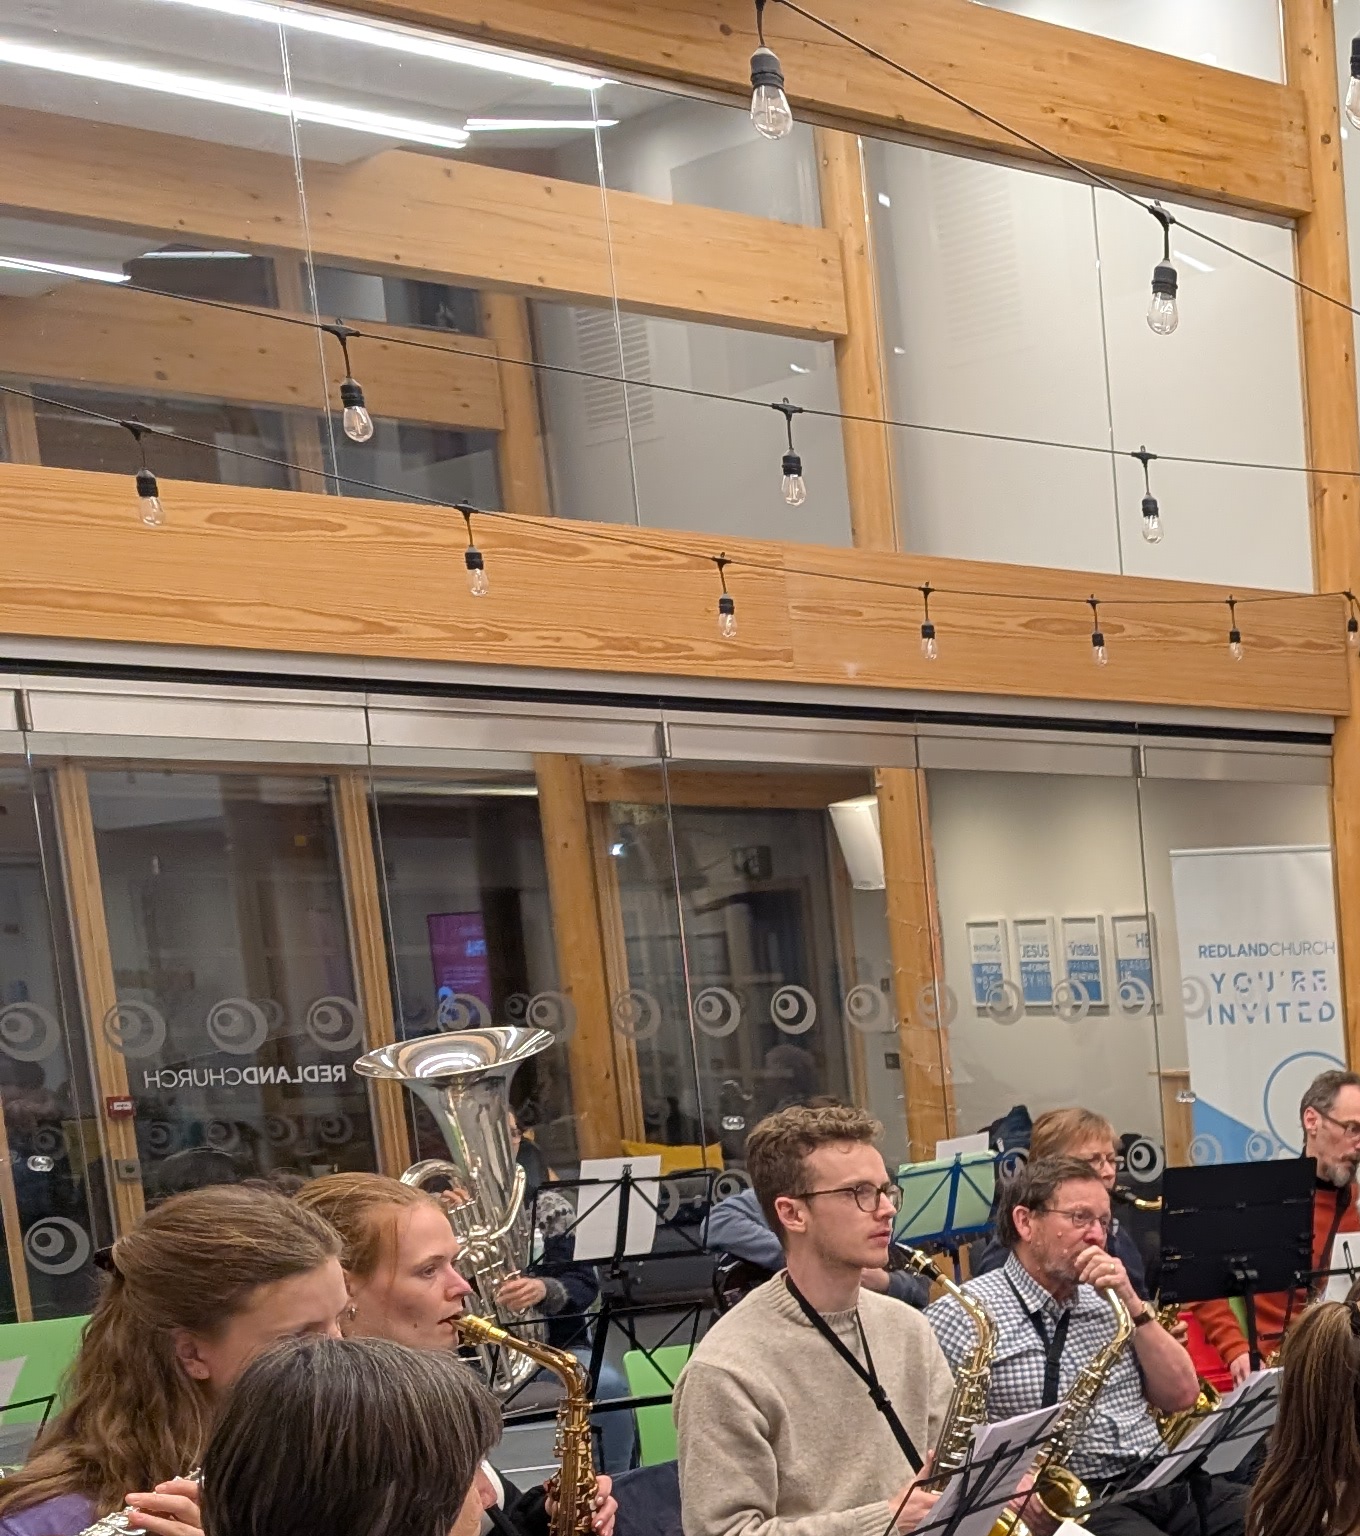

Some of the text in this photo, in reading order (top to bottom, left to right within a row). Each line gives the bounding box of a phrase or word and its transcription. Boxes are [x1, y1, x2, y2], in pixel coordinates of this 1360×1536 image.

[1198, 940, 1336, 959] REDLANDCHURCH
[1210, 969, 1327, 993] YOU'RE
[1207, 1001, 1335, 1025] INVITED
